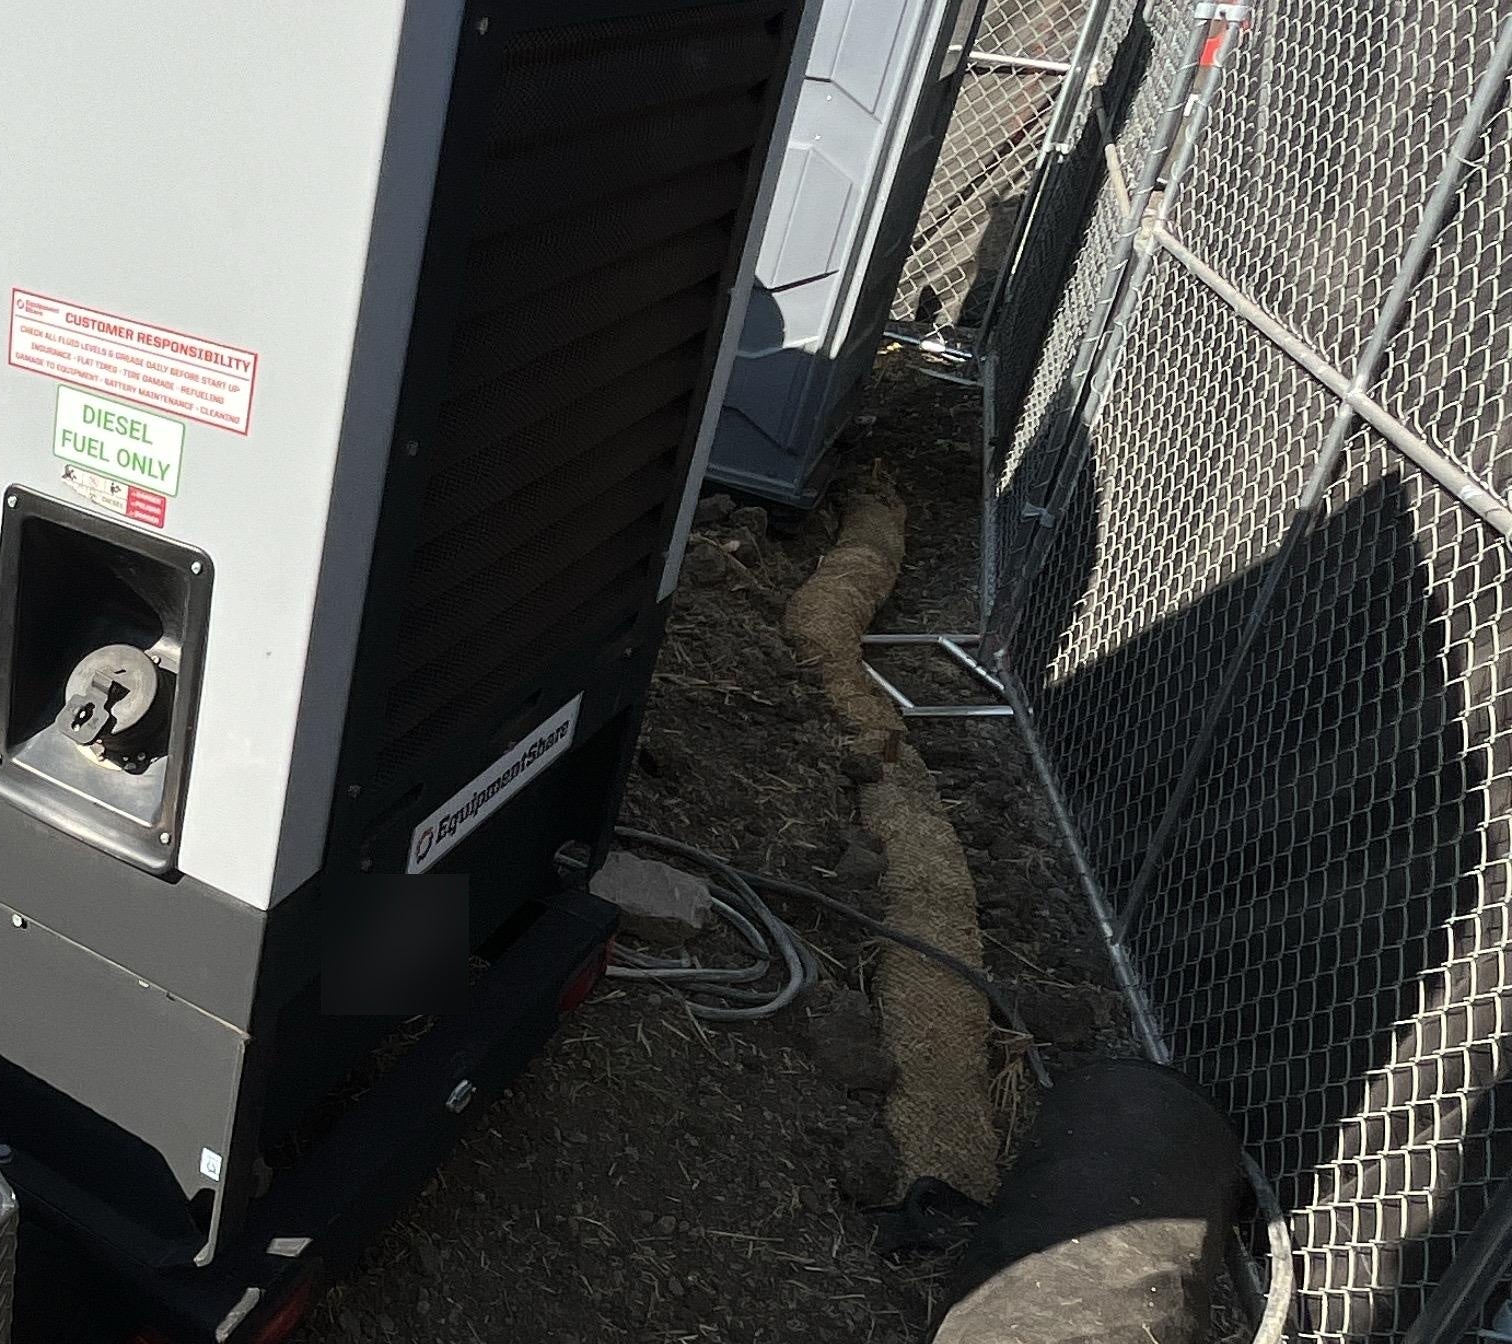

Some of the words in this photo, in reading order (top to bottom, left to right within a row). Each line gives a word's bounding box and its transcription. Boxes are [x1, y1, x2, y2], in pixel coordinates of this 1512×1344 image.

[20, 325, 43, 337] CHECK
[45, 332, 57, 342] ALL
[58, 336, 79, 348] FLUID
[81, 343, 107, 356] LEVELS
[115, 352, 144, 368] GREASE
[146, 361, 168, 373] DAILY
[170, 367, 200, 383] BEFORE
[201, 376, 226, 389] START
[228, 384, 240, 393] UP
[65, 312, 134, 340] CUSTOMER
[137, 331, 251, 373] RESPONSIBILITY
[46, 361, 55, 369] TO
[56, 364, 99, 382] EQUIPMENT
[104, 377, 137, 393] BATTERY
[139, 388, 193, 411] MAINTENANCE
[200, 406, 240, 424] CLEANING
[77, 356, 94, 367] FLAT
[180, 385, 224, 405] REFUELING
[61, 429, 110, 462] FUEL
[116, 448, 170, 481] ONLY
[82, 404, 153, 445] DIESEL
[436, 719, 570, 844] EquipmentShare
